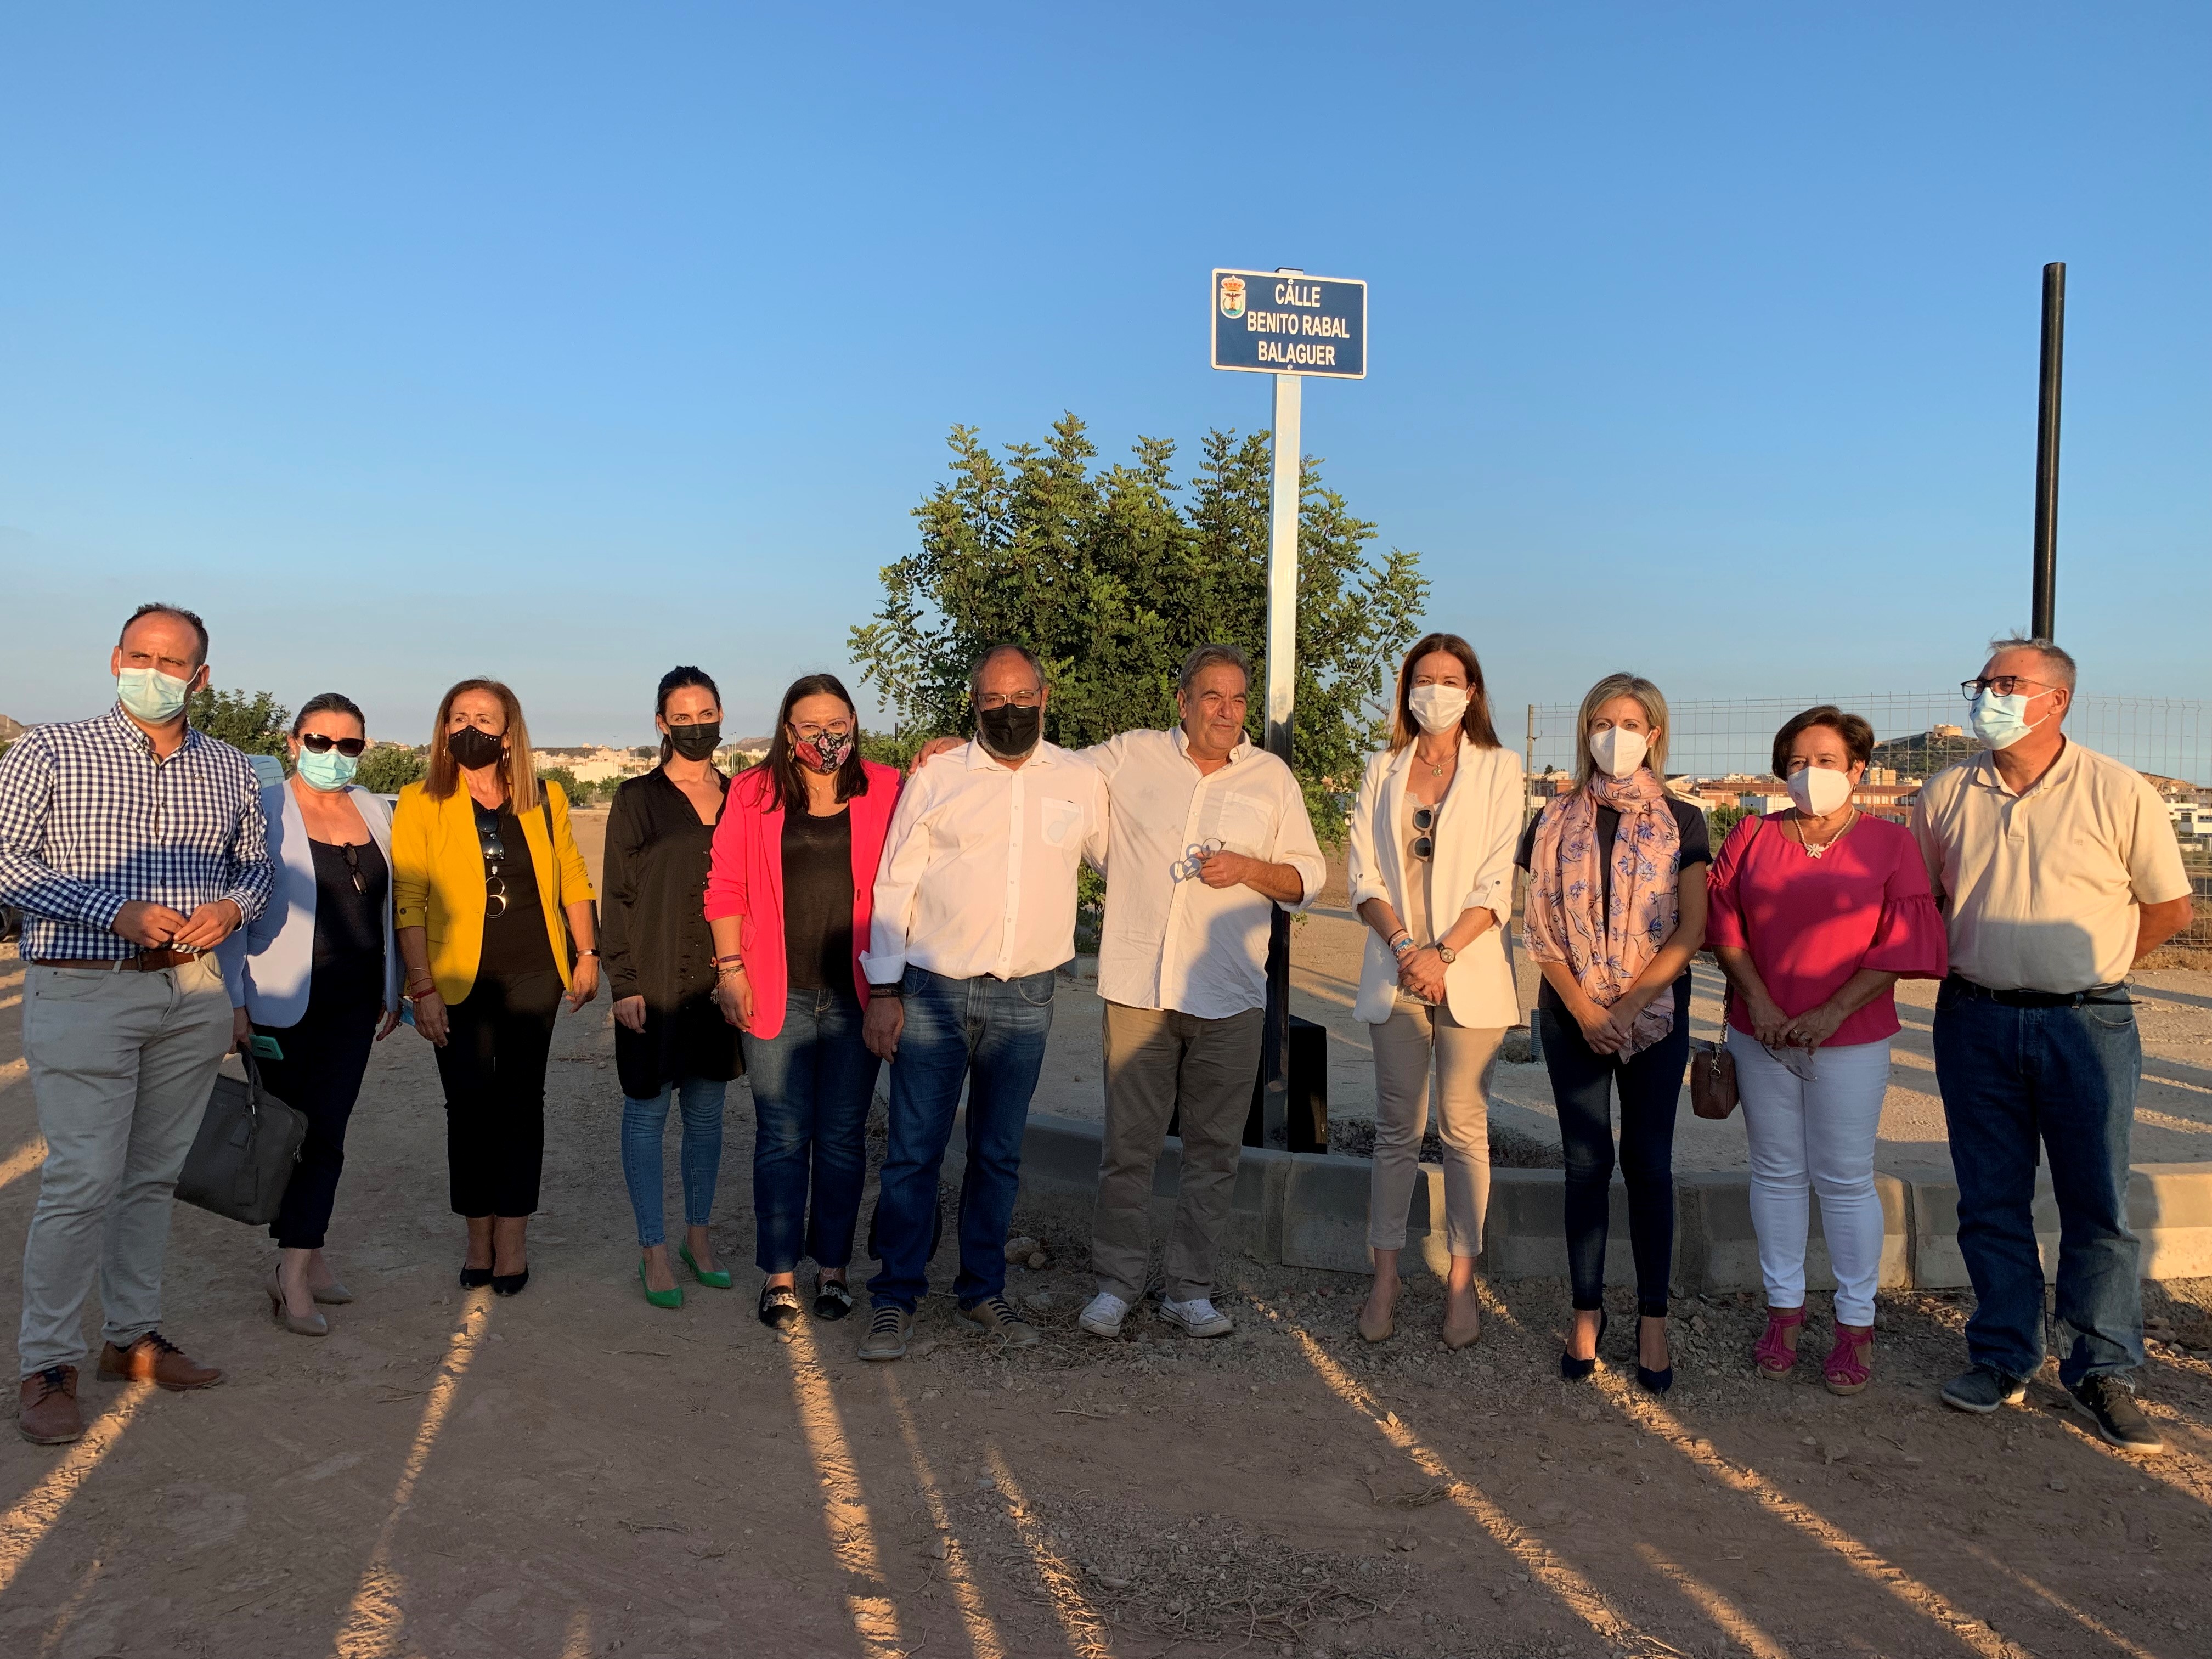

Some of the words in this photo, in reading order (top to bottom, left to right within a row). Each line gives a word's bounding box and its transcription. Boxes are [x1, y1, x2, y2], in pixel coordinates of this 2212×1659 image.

[1275, 284, 1321, 307] CALLE
[1247, 311, 1299, 335] BENITO
[1302, 315, 1350, 338] RABAL
[1258, 341, 1335, 366] BALAGUER
